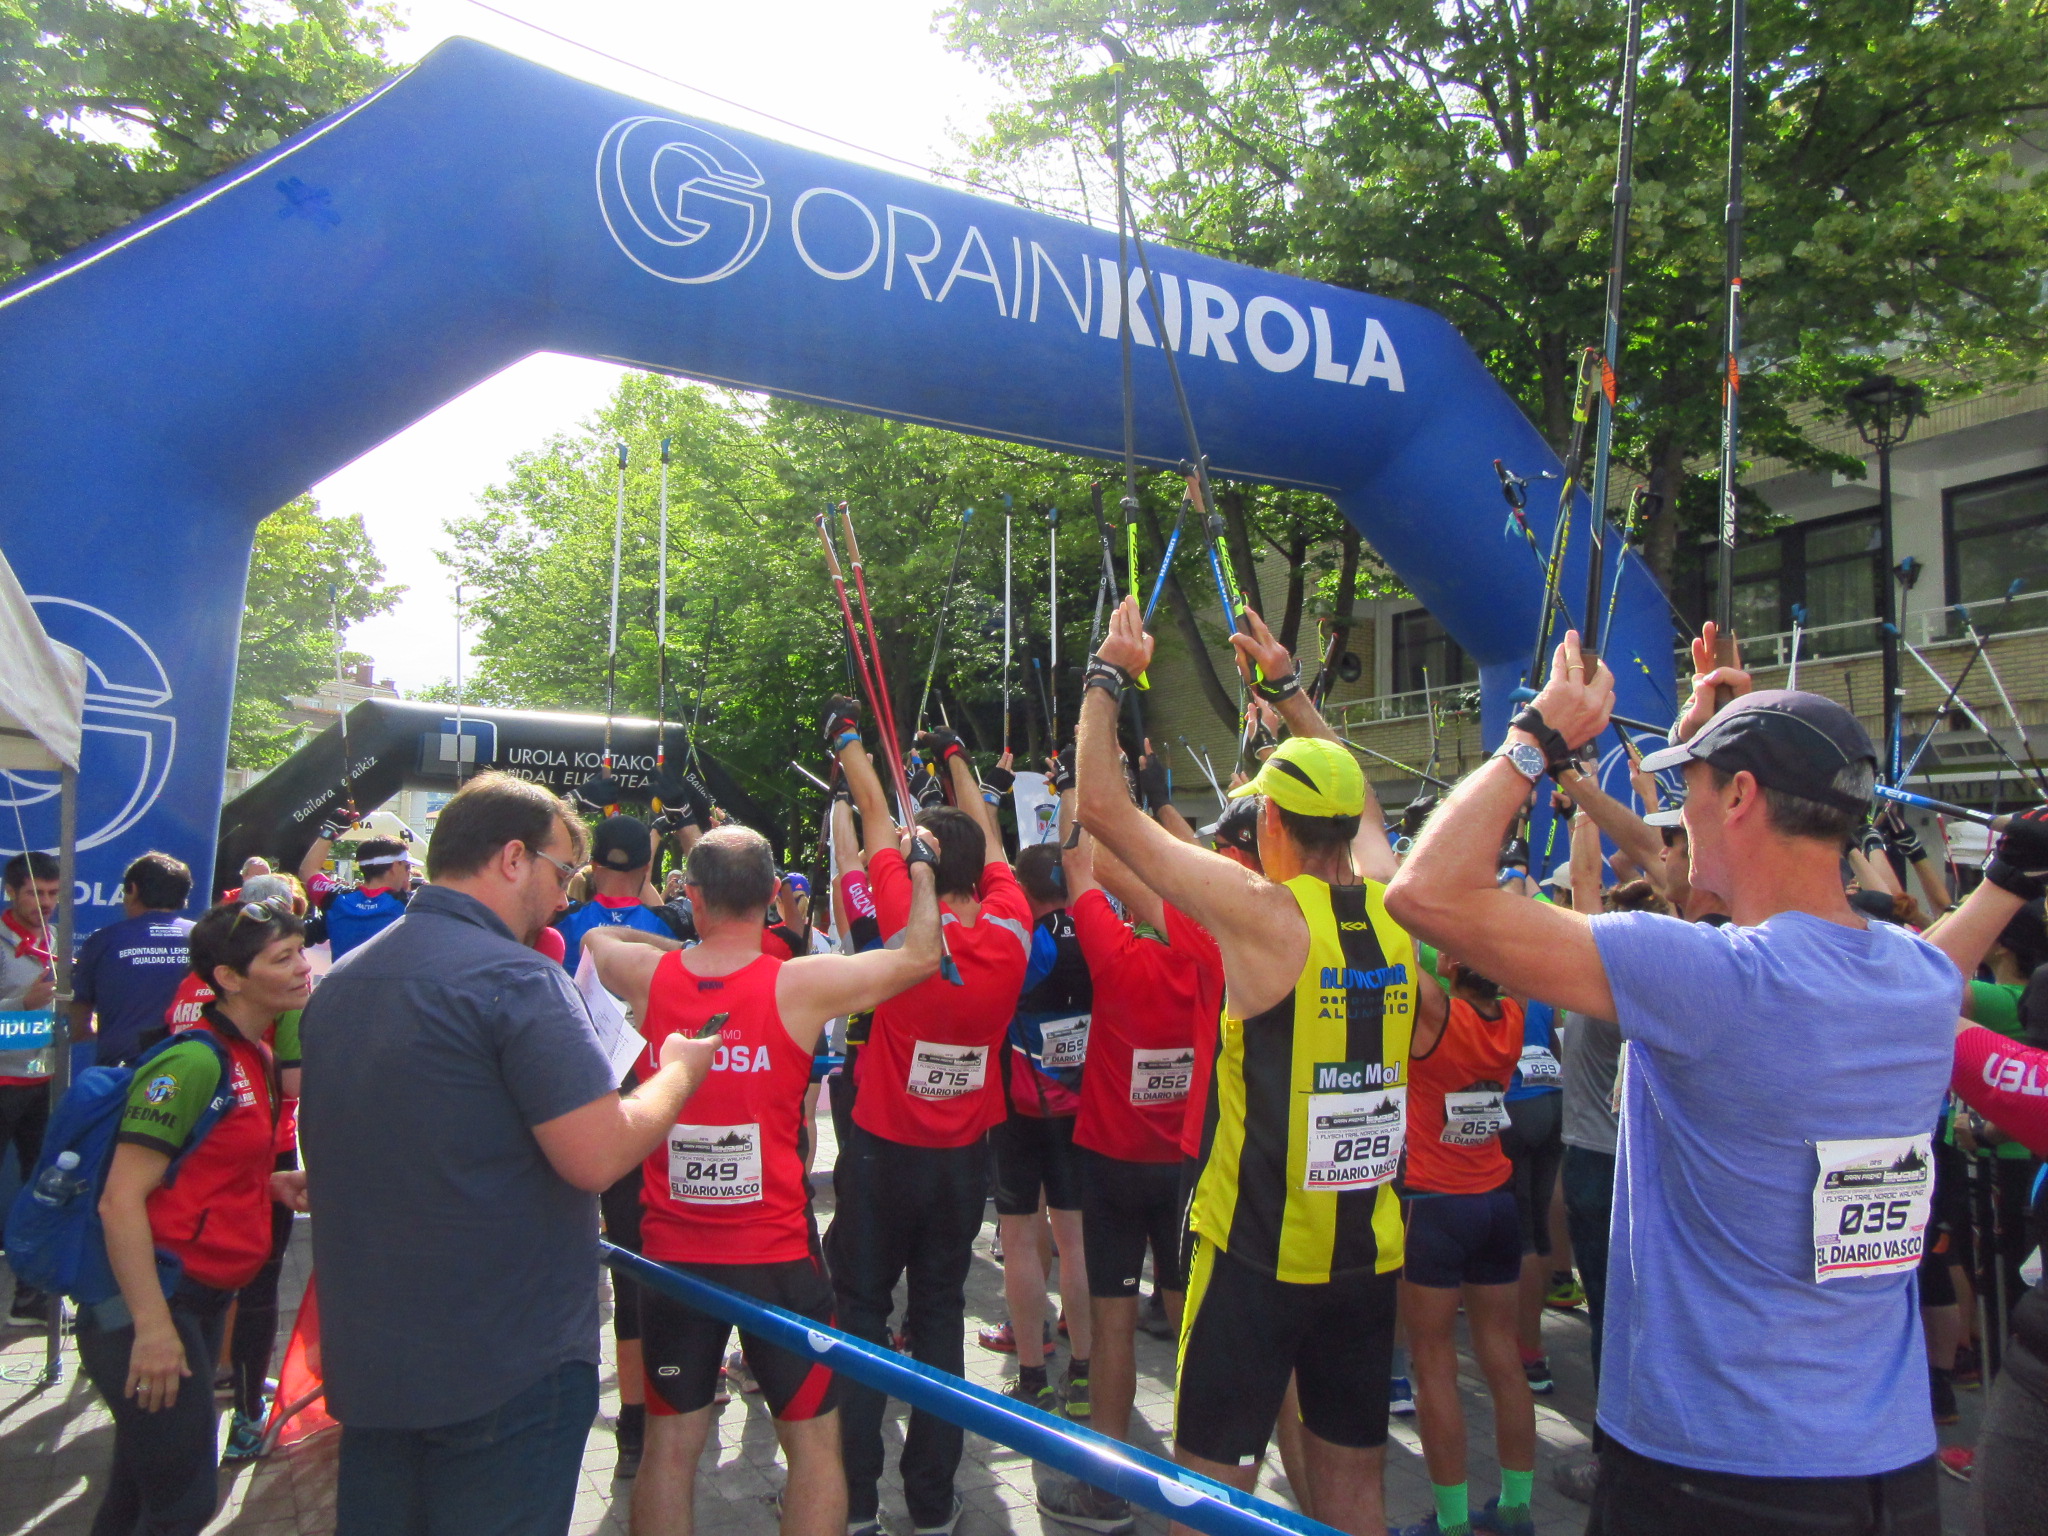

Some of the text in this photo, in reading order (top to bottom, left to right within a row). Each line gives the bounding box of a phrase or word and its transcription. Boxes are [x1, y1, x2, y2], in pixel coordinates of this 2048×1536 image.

[509, 748, 656, 771] UROLA KOTAKO
[293, 756, 378, 822] Bailara eaikiz
[563, 771, 651, 789] ELKTEA
[119, 946, 169, 959] BERDINTASUNA
[132, 955, 165, 965] IGUALDAD
[166, 955, 176, 964] DE
[928, 1070, 969, 1086] 075
[1147, 1074, 1187, 1090] 052
[909, 1084, 919, 1094] EL
[921, 1086, 951, 1096] DIARIO
[1132, 1092, 1142, 1100] EL
[1143, 1091, 1171, 1100] DIARIO
[1333, 1135, 1391, 1162] 028
[686, 1161, 738, 1181] 049
[1309, 1158, 1397, 1181] EL DIARIO VASCO
[671, 1182, 760, 1196] EL DIARIO VASCO
[1839, 1200, 1911, 1236] 035
[1817, 1236, 1922, 1266] EL DIARIO VASCO
